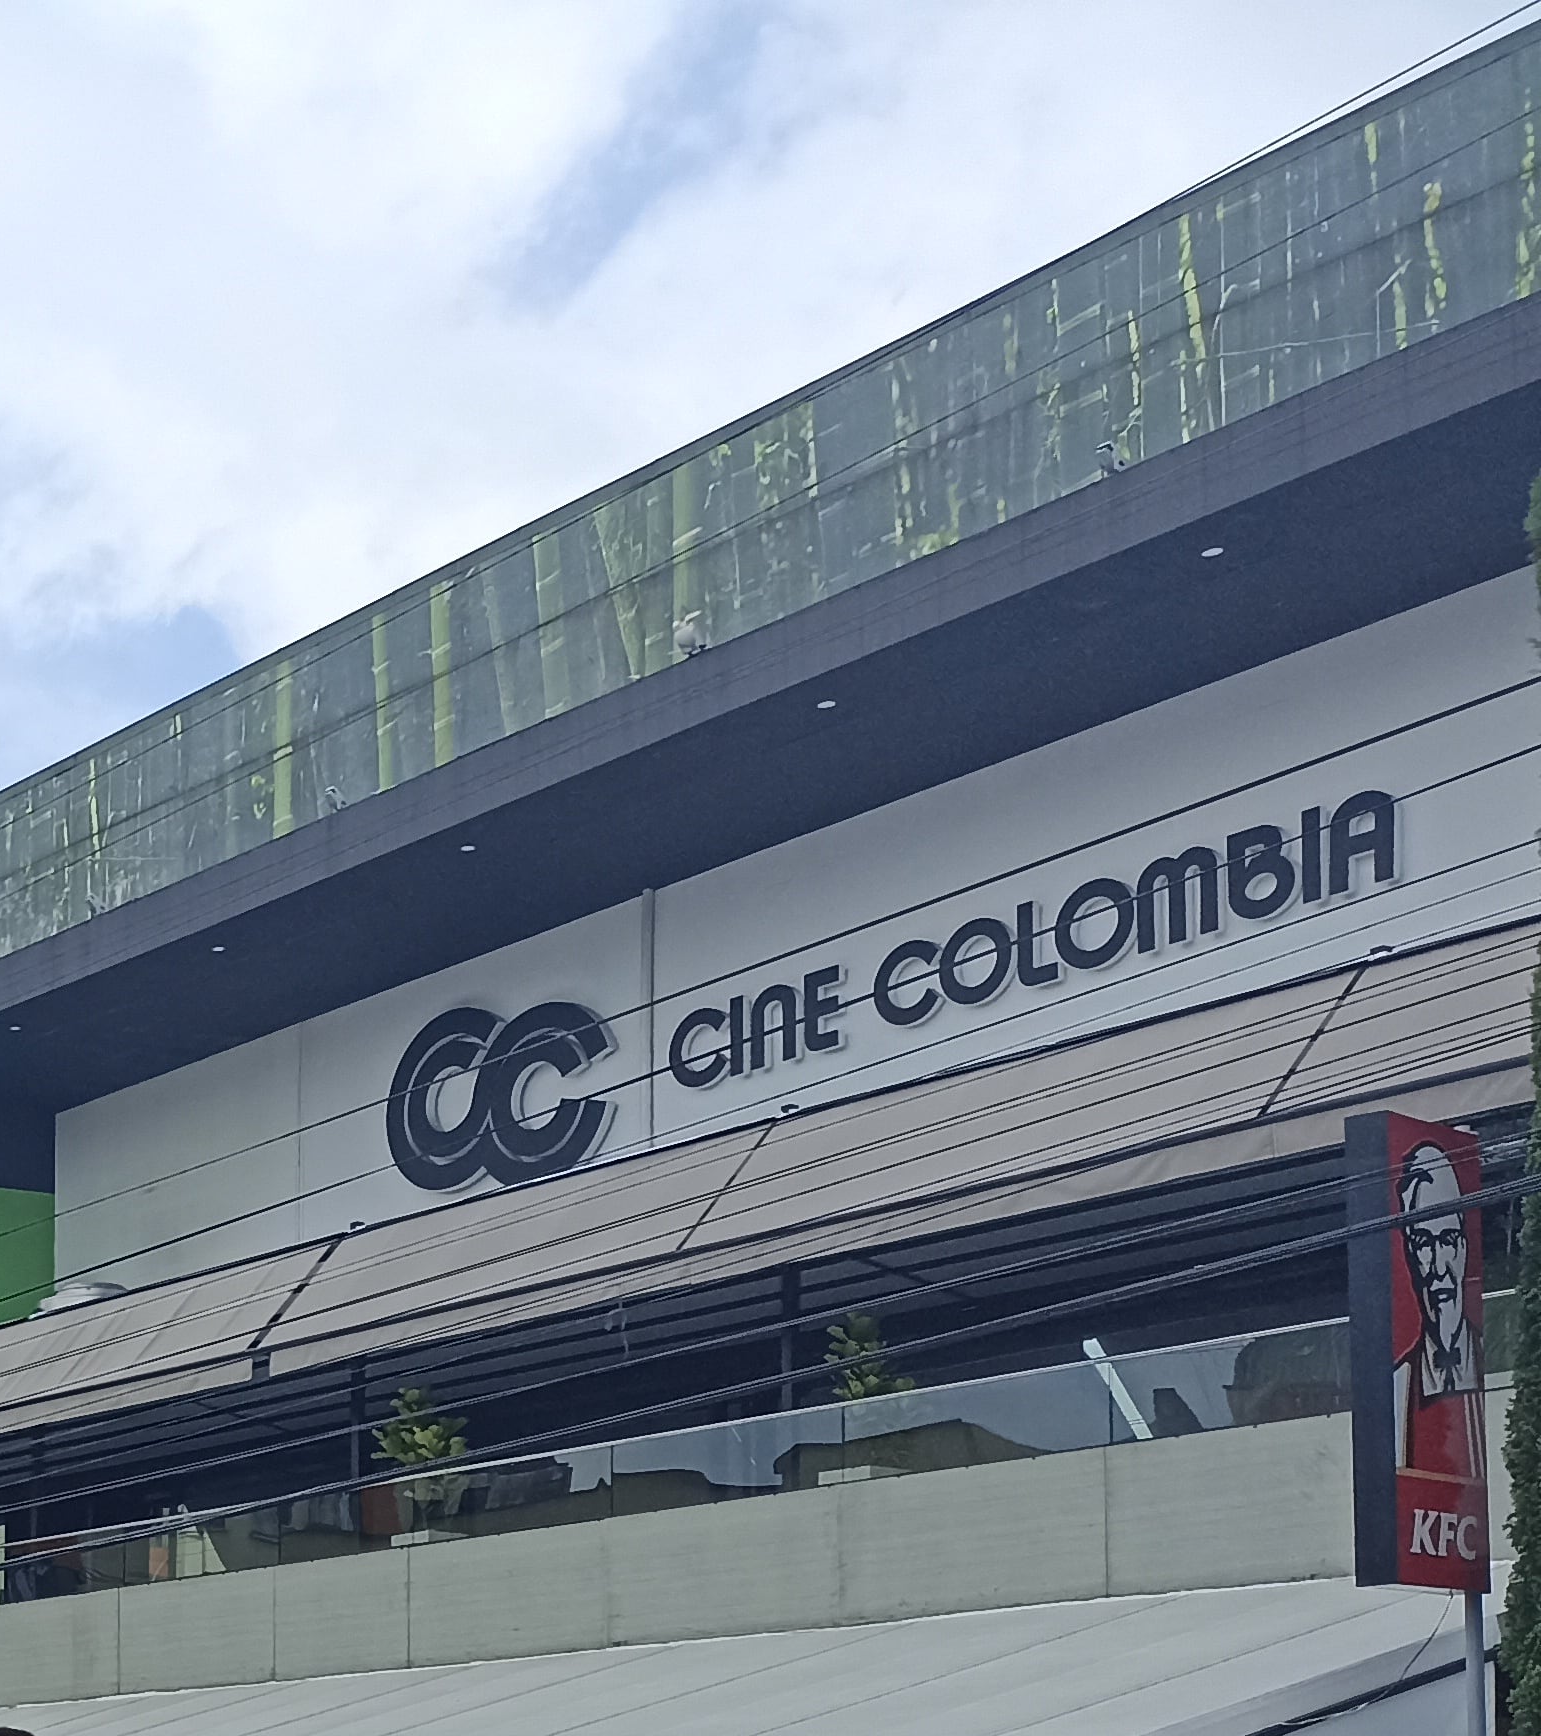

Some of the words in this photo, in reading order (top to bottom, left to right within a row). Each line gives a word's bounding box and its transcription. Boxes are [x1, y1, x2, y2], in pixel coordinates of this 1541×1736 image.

[669, 964, 843, 1088] CINE
[873, 790, 1396, 1026] COLOMBIA
[1410, 1508, 1478, 1561] KFC
